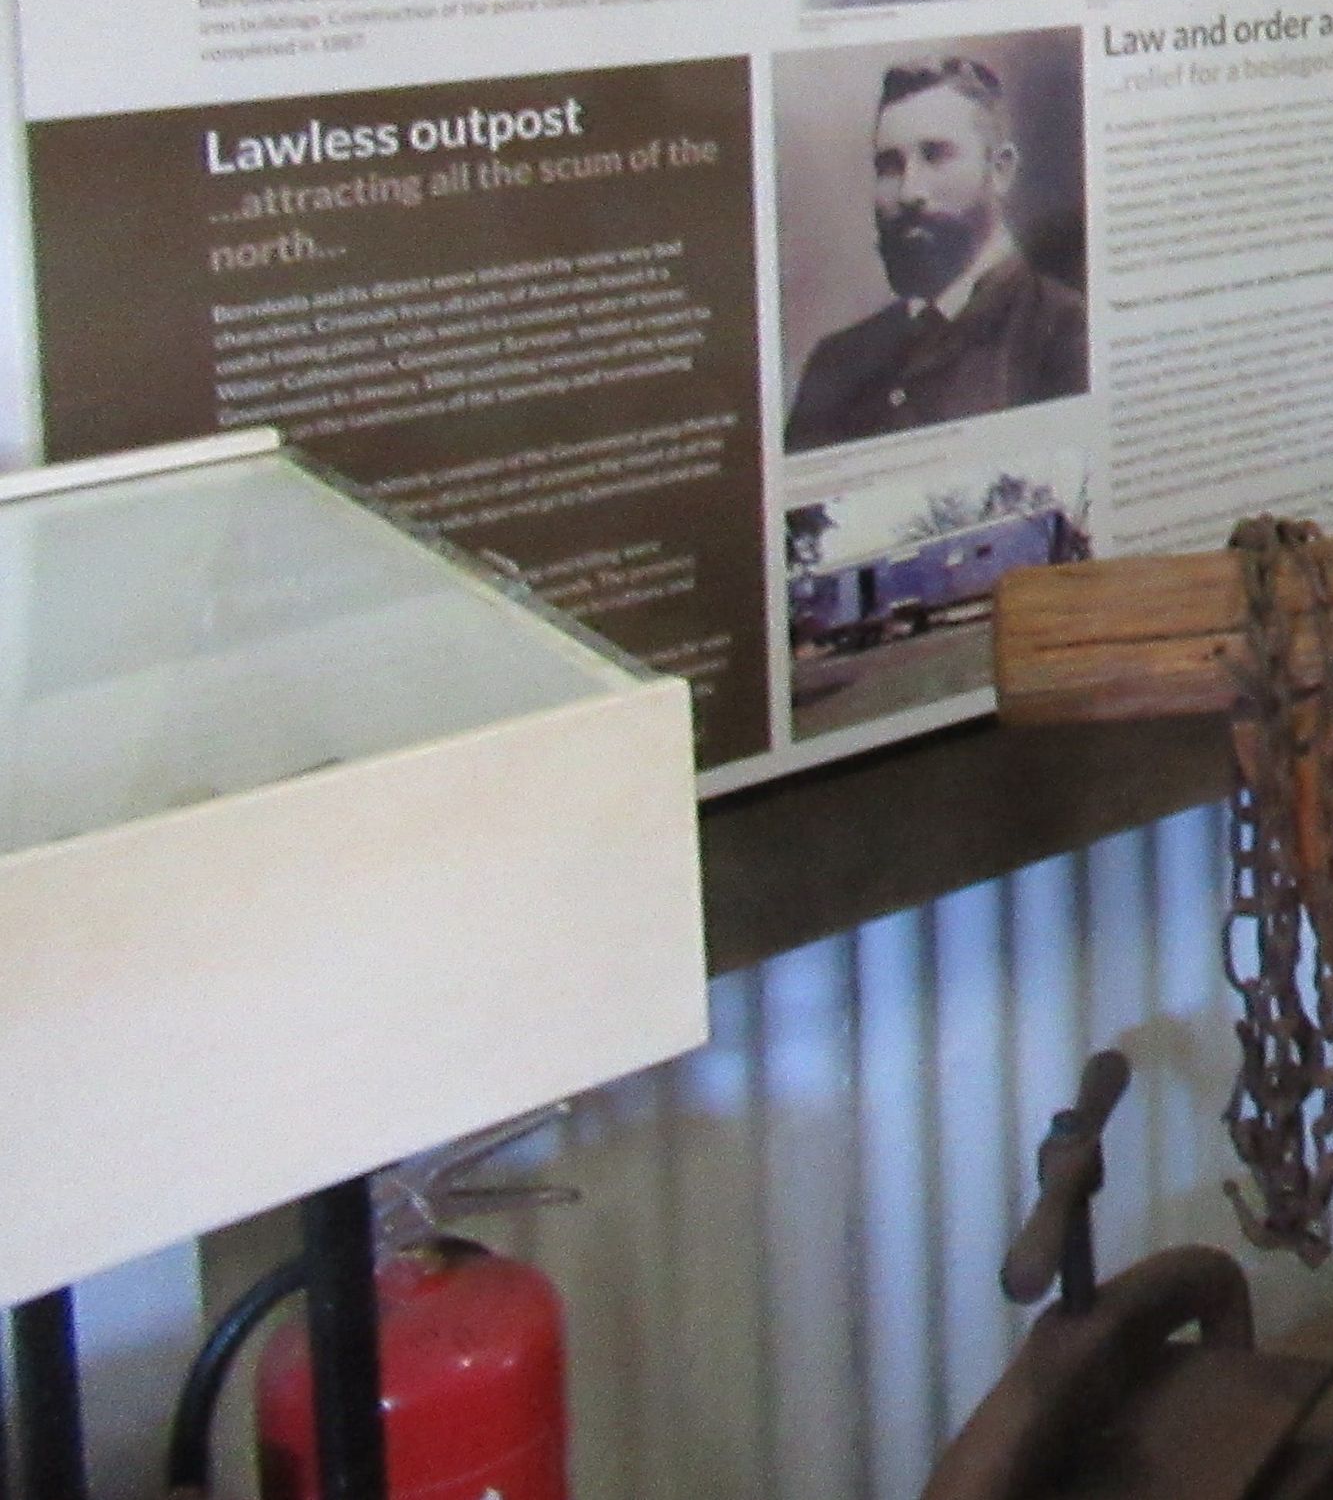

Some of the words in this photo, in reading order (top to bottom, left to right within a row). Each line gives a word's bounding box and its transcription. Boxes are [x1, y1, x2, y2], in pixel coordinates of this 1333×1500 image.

[1103, 23, 1165, 57] Law
[1173, 14, 1227, 50] and
[1233, 10, 1311, 45] order
[1188, 59, 1219, 86] for
[1226, 64, 1239, 83] a
[207, 118, 400, 176] Lawless
[408, 96, 584, 160] outpost
[428, 162, 471, 197] all
[477, 157, 533, 190] the
[540, 151, 622, 184] scum
[629, 143, 663, 172] of
[668, 136, 718, 166] the
